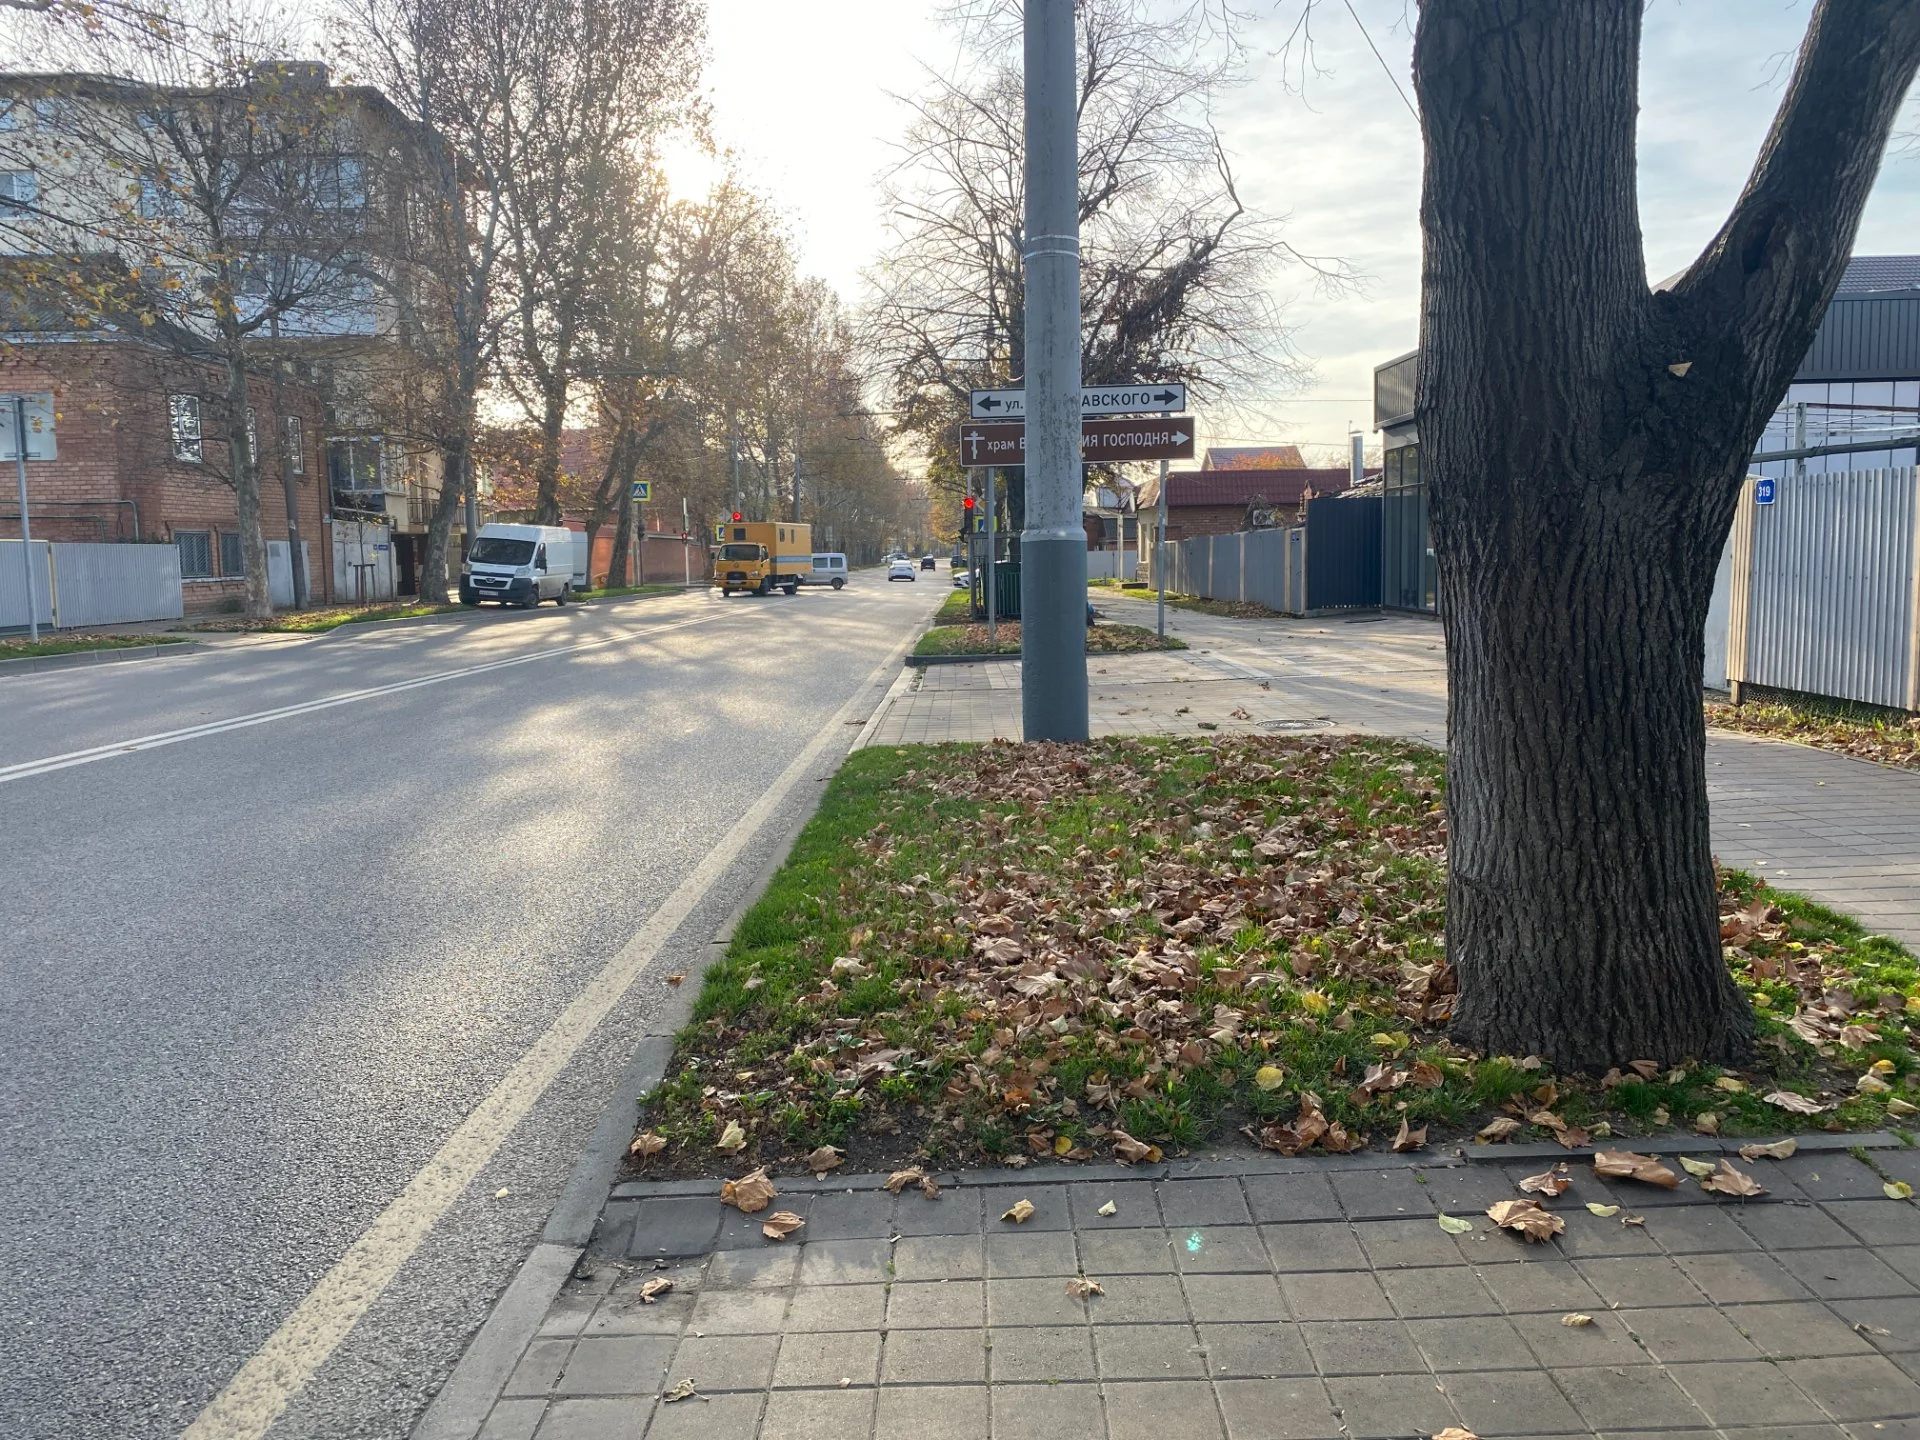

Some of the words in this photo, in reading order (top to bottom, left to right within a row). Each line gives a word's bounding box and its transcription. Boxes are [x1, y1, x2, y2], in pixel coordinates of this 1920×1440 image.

[1005, 400, 1023, 413] ул.
[1081, 392, 1151, 408] АВСКОГО
[987, 440, 1015, 453] храм
[1103, 432, 1169, 448] ГОСПОДНЯ
[1758, 485, 1771, 497] 319
